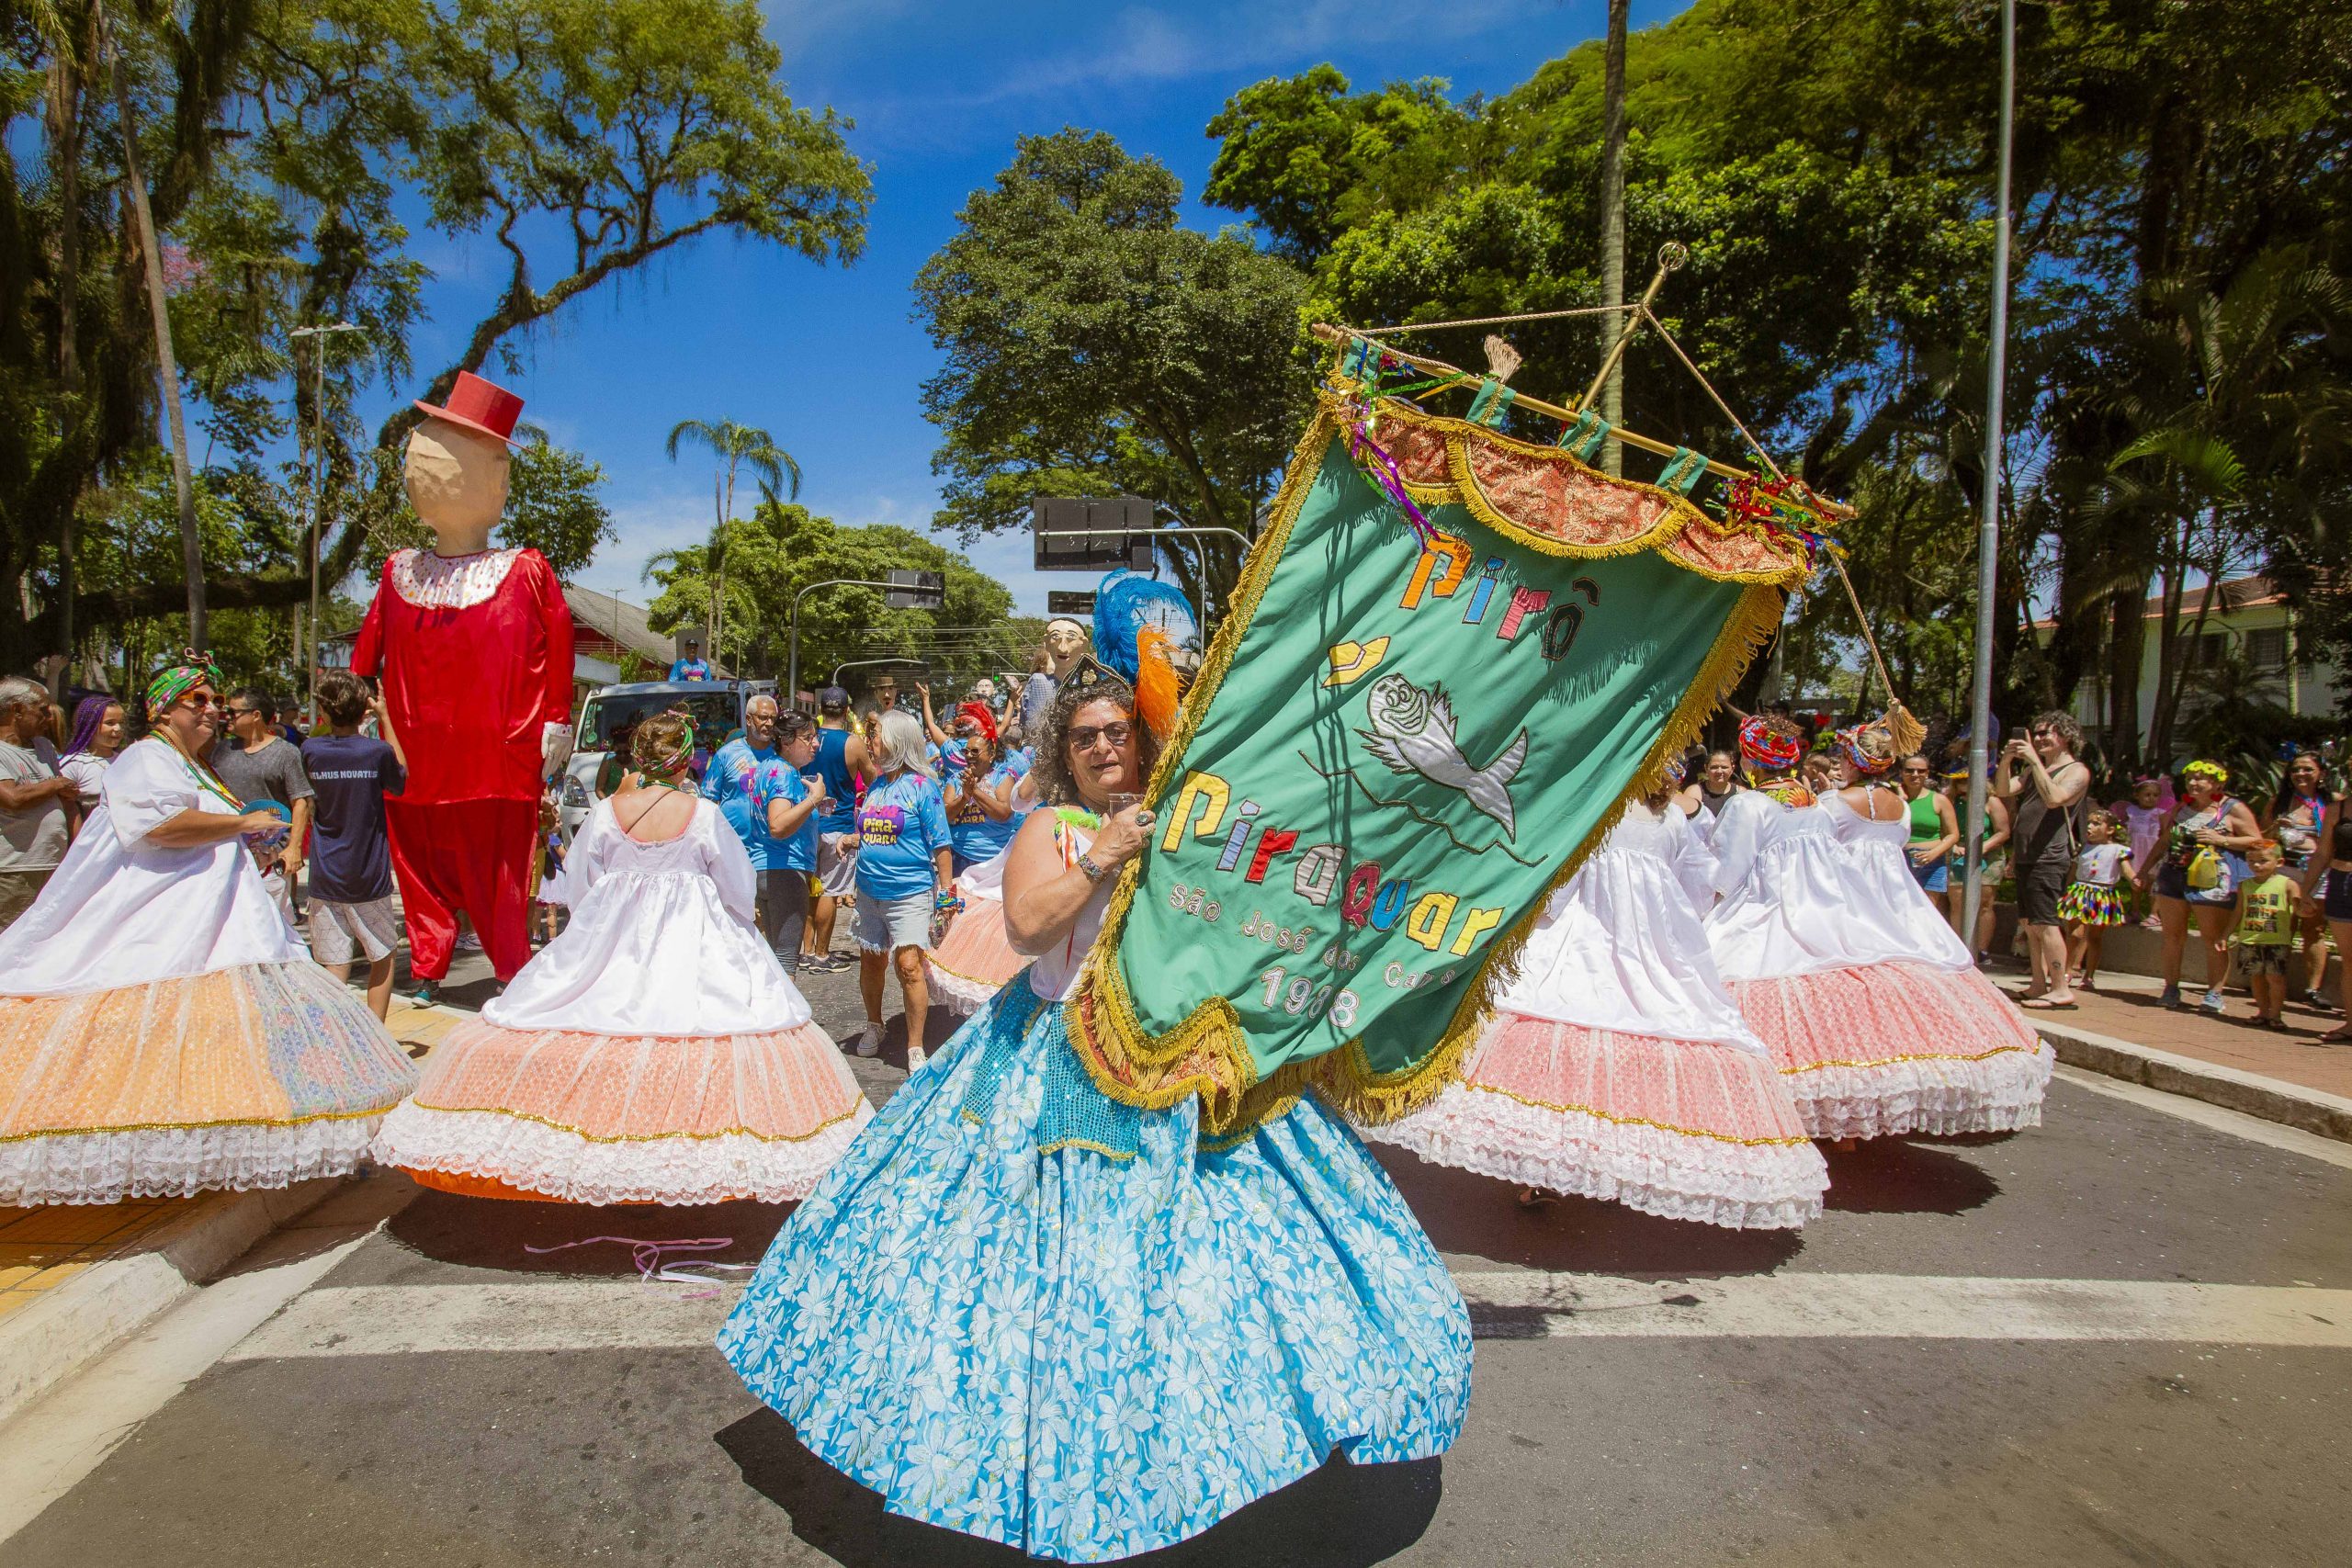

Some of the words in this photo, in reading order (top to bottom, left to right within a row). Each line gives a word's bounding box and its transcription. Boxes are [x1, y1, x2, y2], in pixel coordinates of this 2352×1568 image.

[1398, 531, 1600, 661] Pirô
[1169, 883, 1222, 922] São
[1243, 910, 1315, 954] José
[1261, 965, 1360, 1028] 1988
